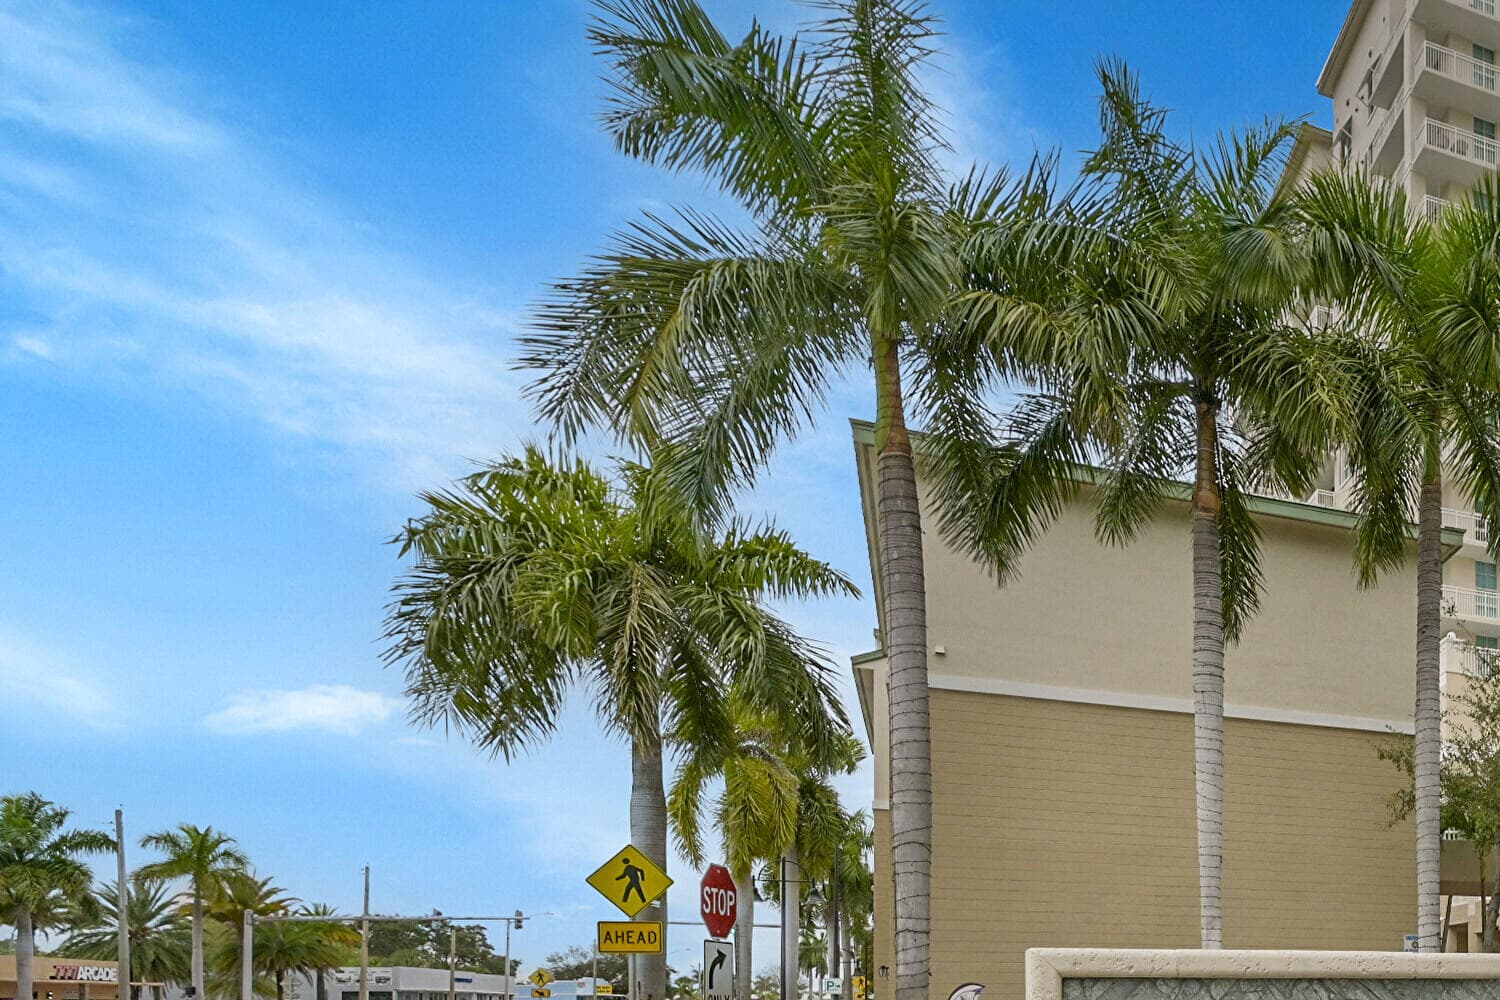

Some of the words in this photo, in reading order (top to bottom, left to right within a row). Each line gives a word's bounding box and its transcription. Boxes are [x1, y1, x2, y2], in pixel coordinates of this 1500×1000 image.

[702, 886, 735, 916] STOP
[603, 931, 657, 944] AHEAD
[77, 967, 117, 981] ARCADE
